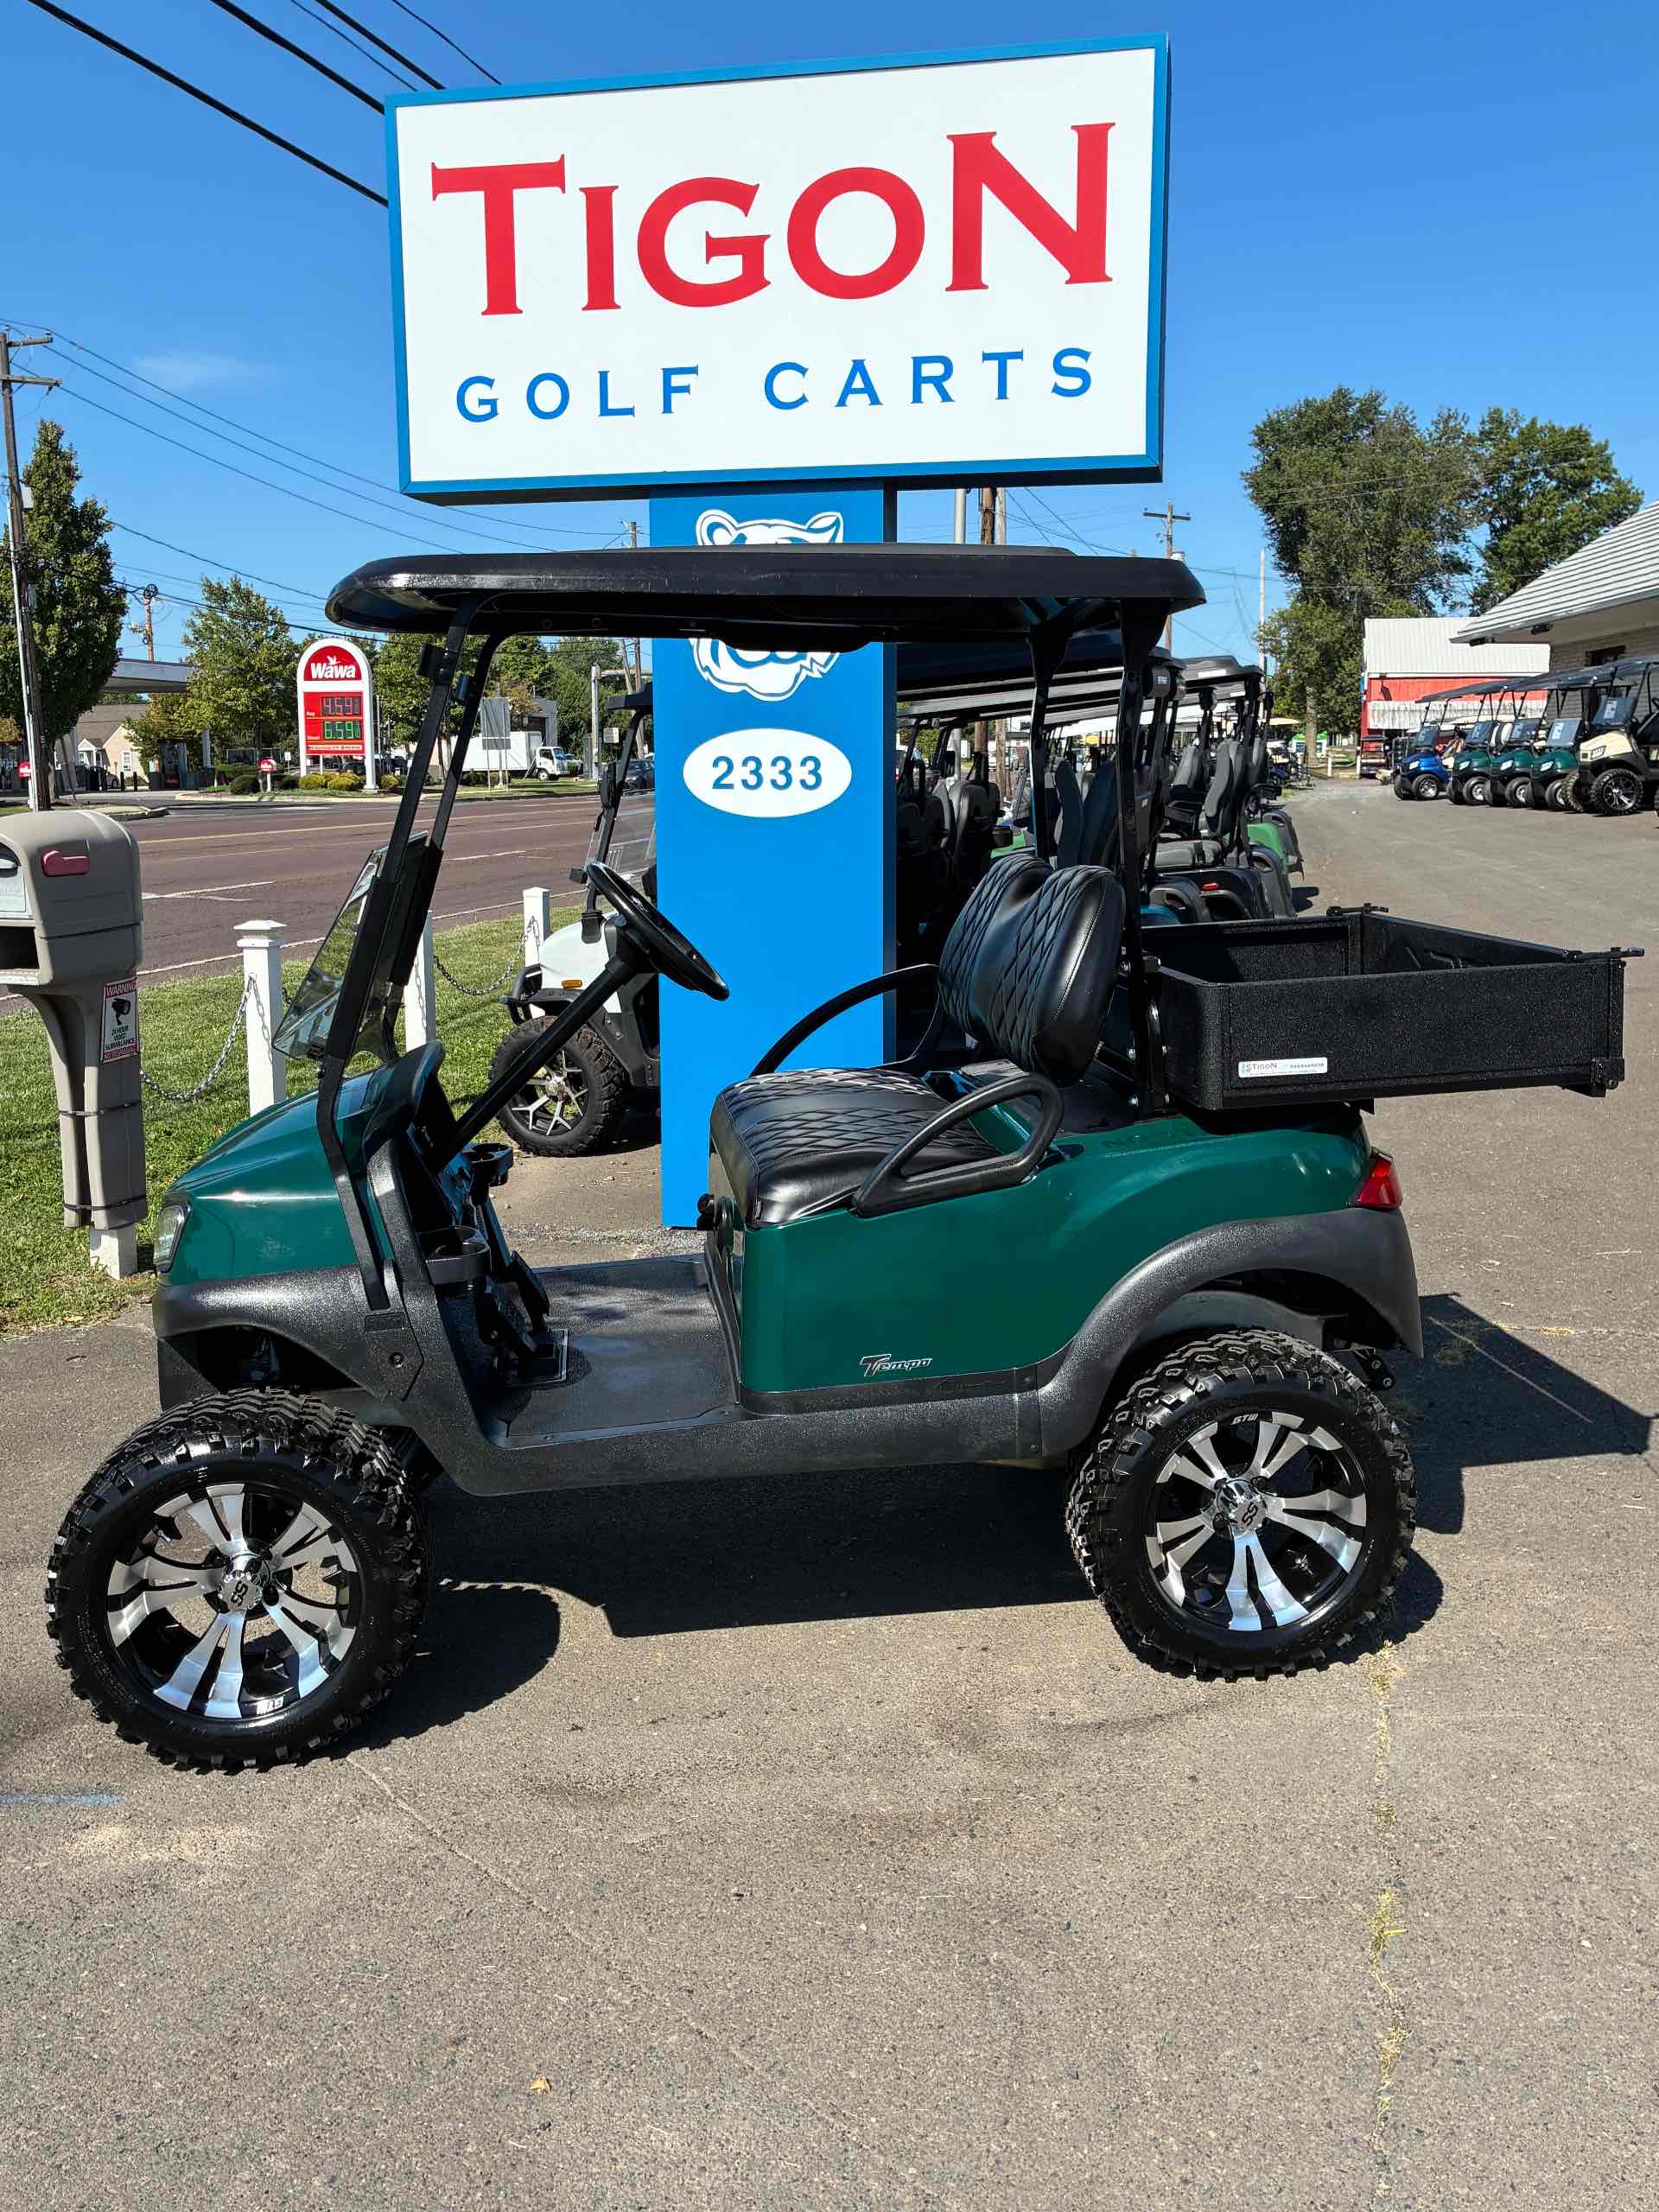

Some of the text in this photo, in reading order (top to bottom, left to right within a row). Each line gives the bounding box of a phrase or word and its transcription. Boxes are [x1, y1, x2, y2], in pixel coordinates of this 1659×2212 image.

[431, 122, 1115, 315] TIGON
[456, 347, 1092, 423] GOLF CARTS
[310, 663, 355, 679] Wawa
[712, 755, 823, 791] 2333
[106, 982, 136, 996] WARNING
[860, 1353, 933, 1376] Tempo
